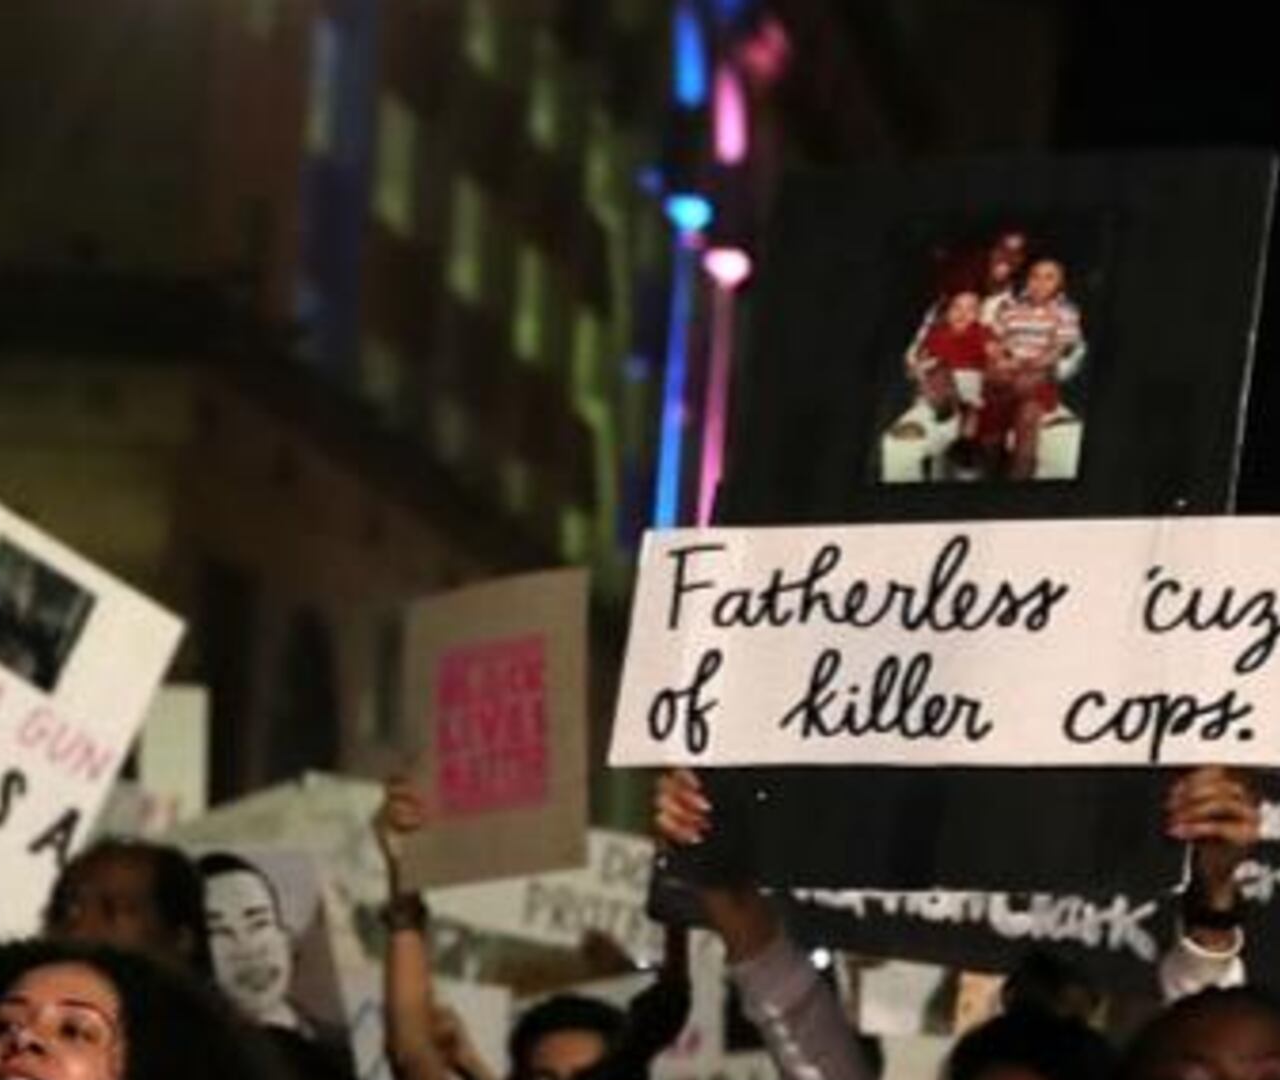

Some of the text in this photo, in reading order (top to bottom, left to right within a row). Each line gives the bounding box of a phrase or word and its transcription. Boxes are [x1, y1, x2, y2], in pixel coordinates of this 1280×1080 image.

[666, 536, 1070, 634] Fatherless
[14, 703, 116, 782] GUN
[647, 649, 1255, 763] of killer cops.
[26, 807, 83, 866] A
